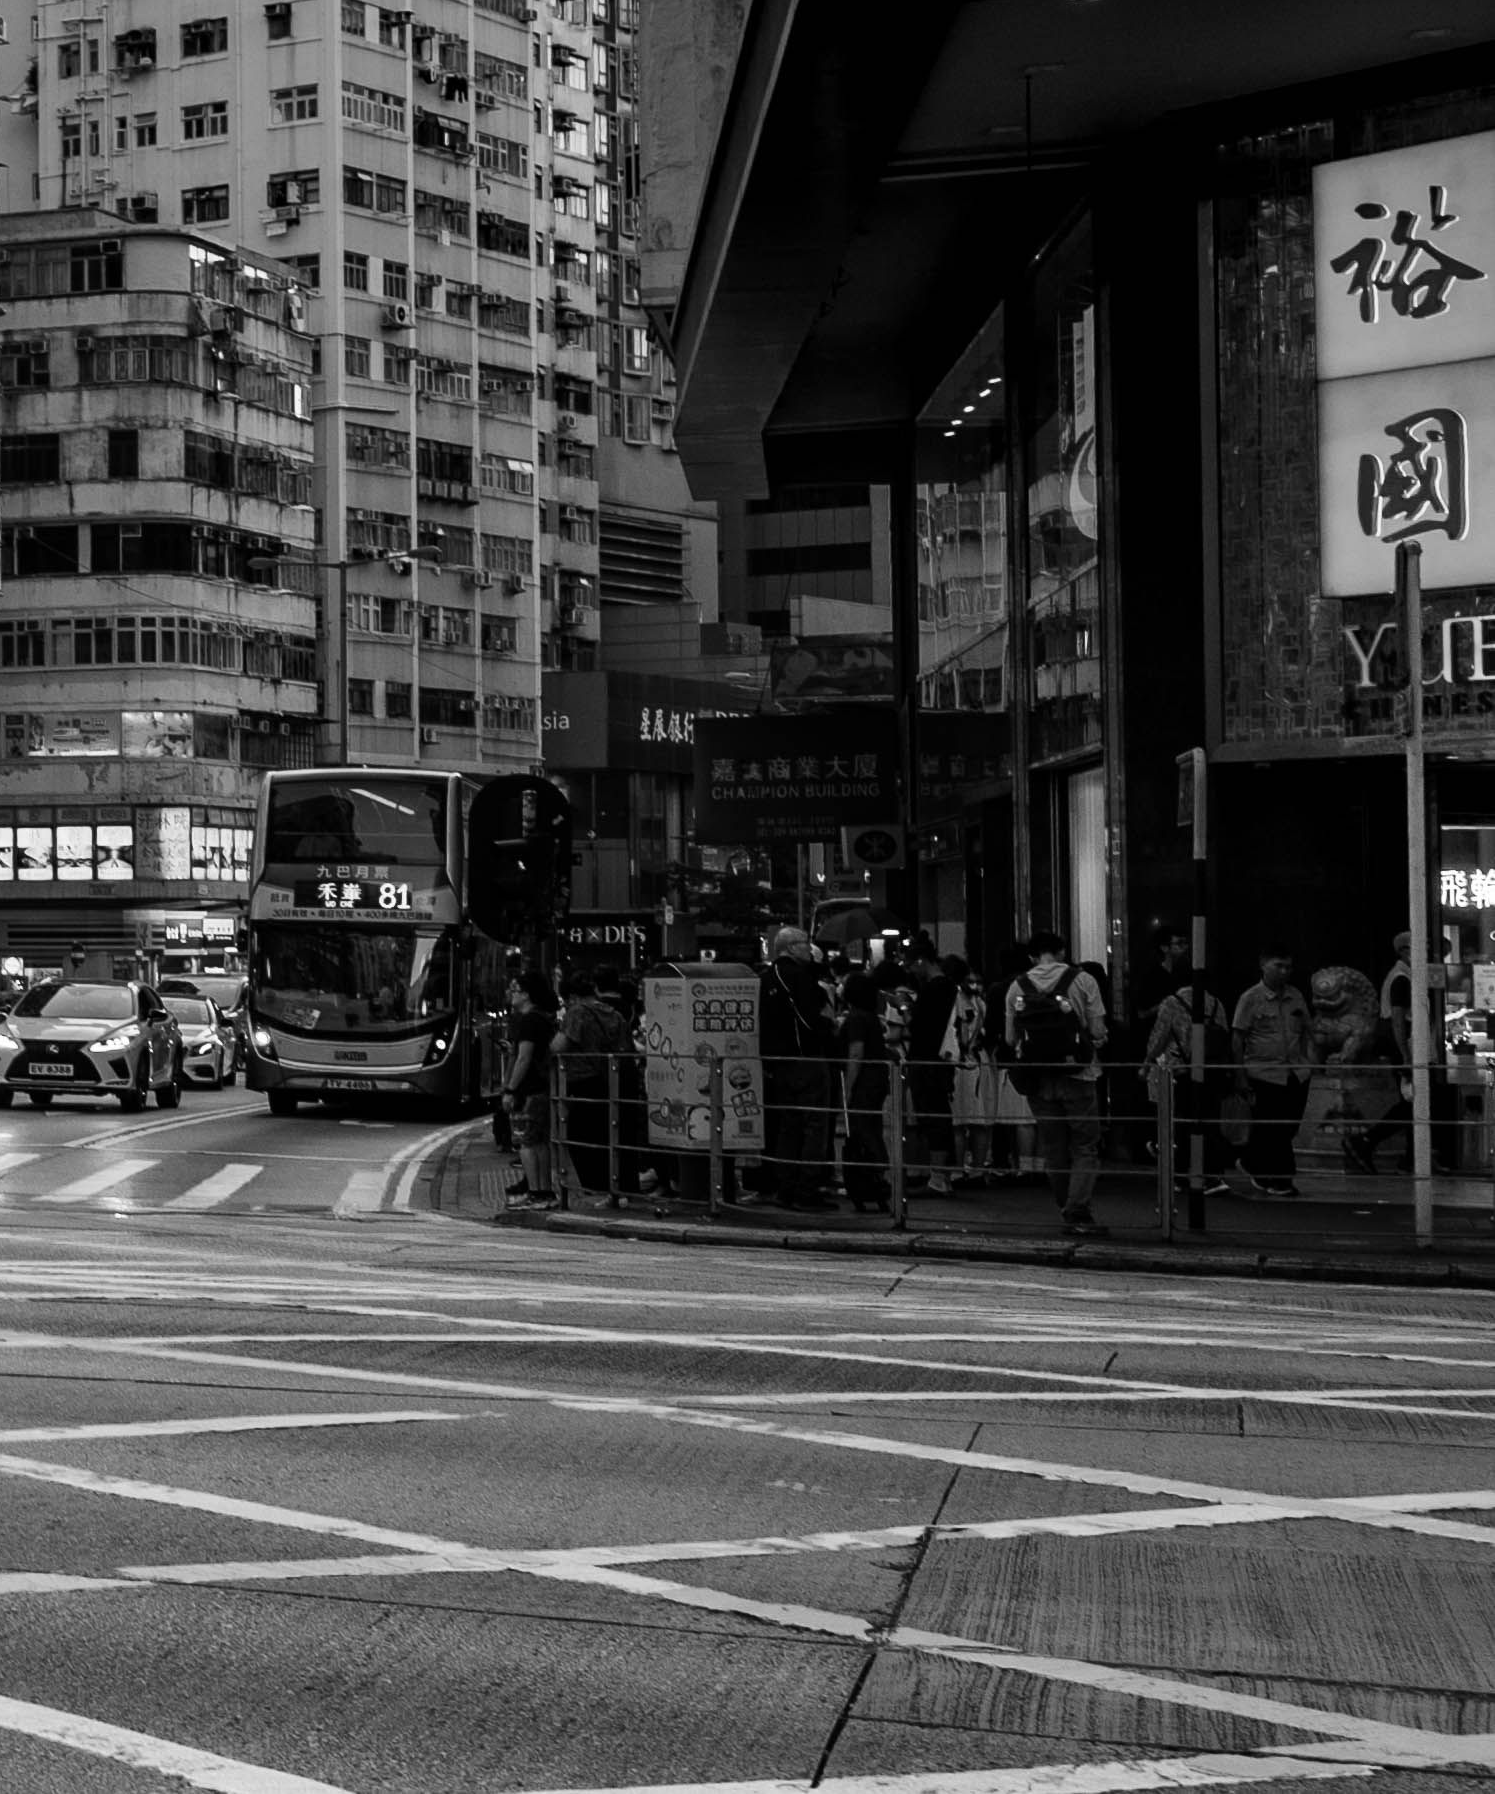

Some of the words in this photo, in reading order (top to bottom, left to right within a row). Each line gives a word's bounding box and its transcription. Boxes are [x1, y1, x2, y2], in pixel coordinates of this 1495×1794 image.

[1330, 184, 1488, 543] 裕國
[541, 709, 571, 731] sia
[710, 785, 800, 801] CHAMPION
[804, 782, 881, 799] BUILDING
[316, 864, 390, 880] 九巴月票
[378, 882, 411, 909] 81
